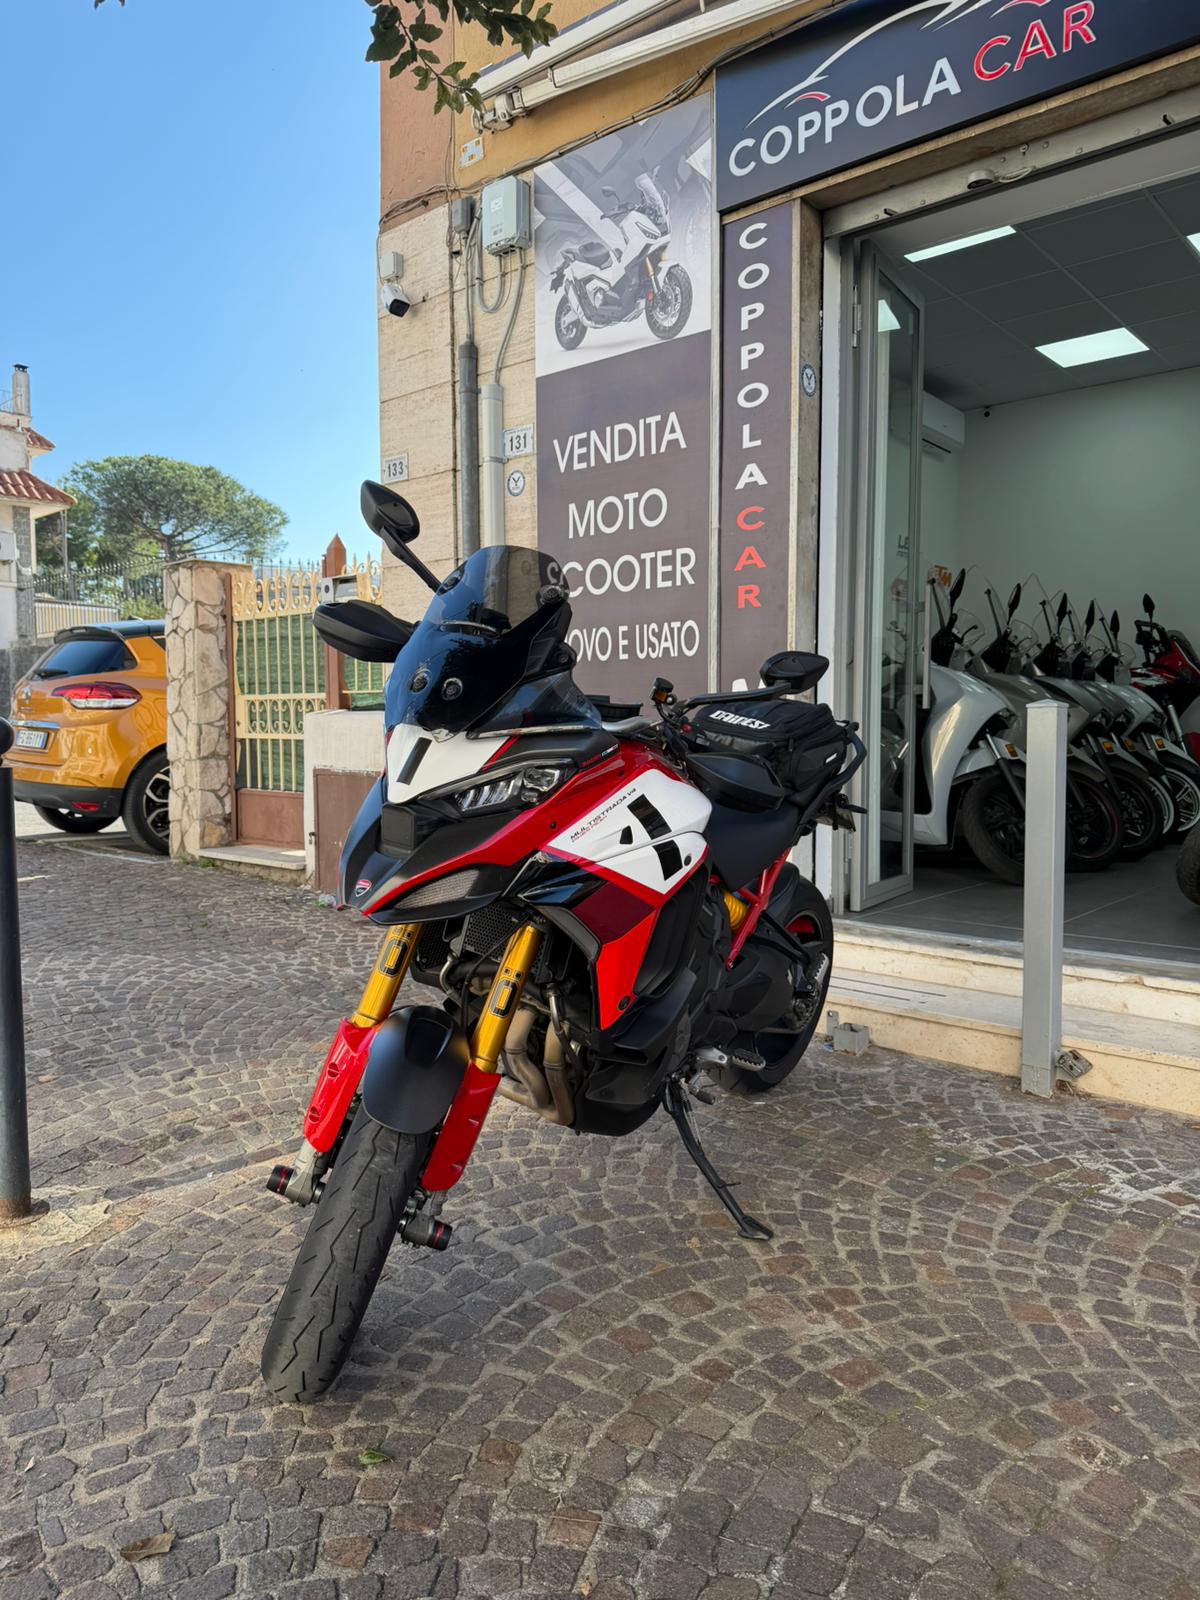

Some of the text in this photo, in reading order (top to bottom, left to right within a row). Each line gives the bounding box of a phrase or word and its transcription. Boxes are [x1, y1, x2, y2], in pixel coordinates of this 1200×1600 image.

[728, 0, 1096, 177] COPPOLA CAR
[734, 222, 770, 609] COPPOLA CAR
[509, 432, 527, 452] 131
[552, 411, 687, 473] VENDITA
[387, 460, 404, 478] 133
[568, 488, 668, 539] MOTO
[564, 619, 700, 663] OVO E USATO
